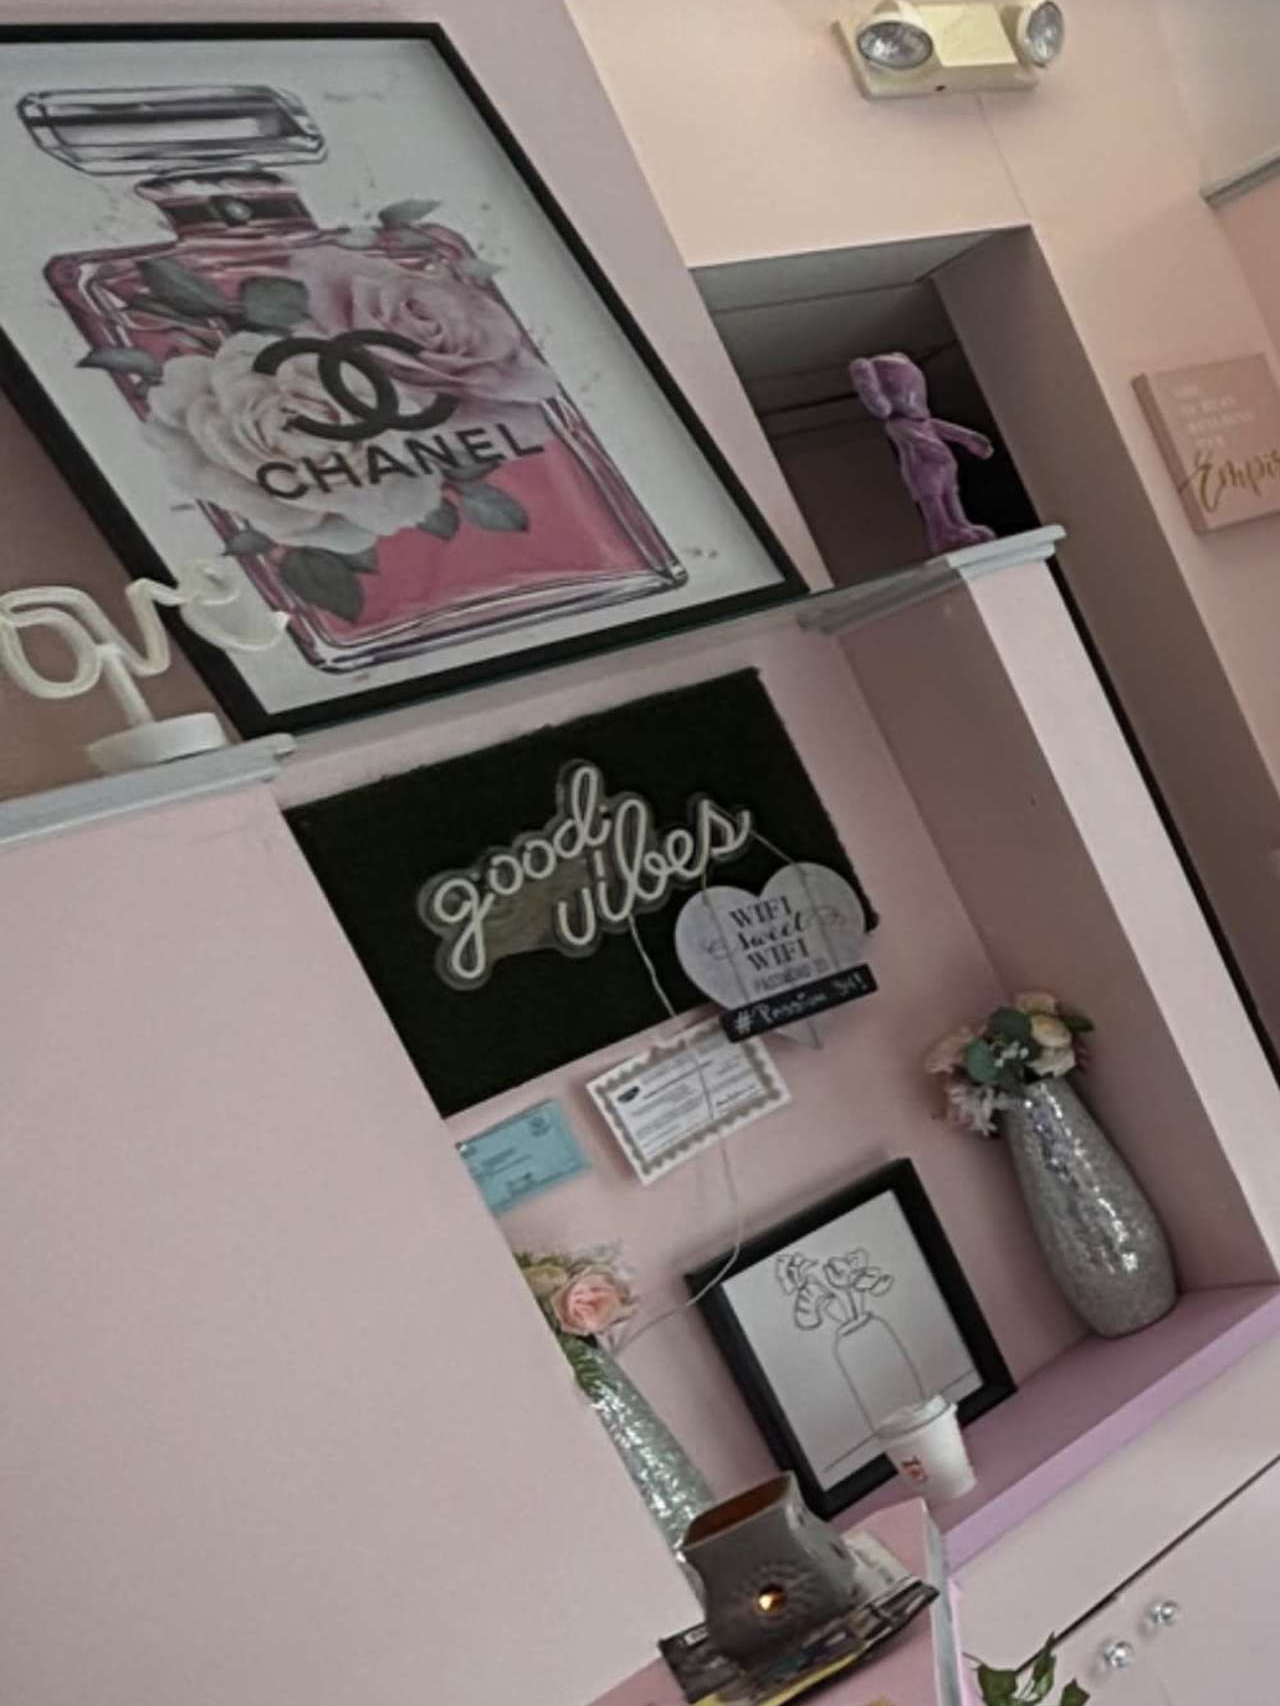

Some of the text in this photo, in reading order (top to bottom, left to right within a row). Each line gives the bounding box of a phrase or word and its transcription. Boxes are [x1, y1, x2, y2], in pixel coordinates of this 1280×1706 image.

[256, 422, 545, 500] CHANEL
[433, 765, 613, 980] good
[557, 799, 751, 946] vibes
[746, 937, 809, 972] WIFI
